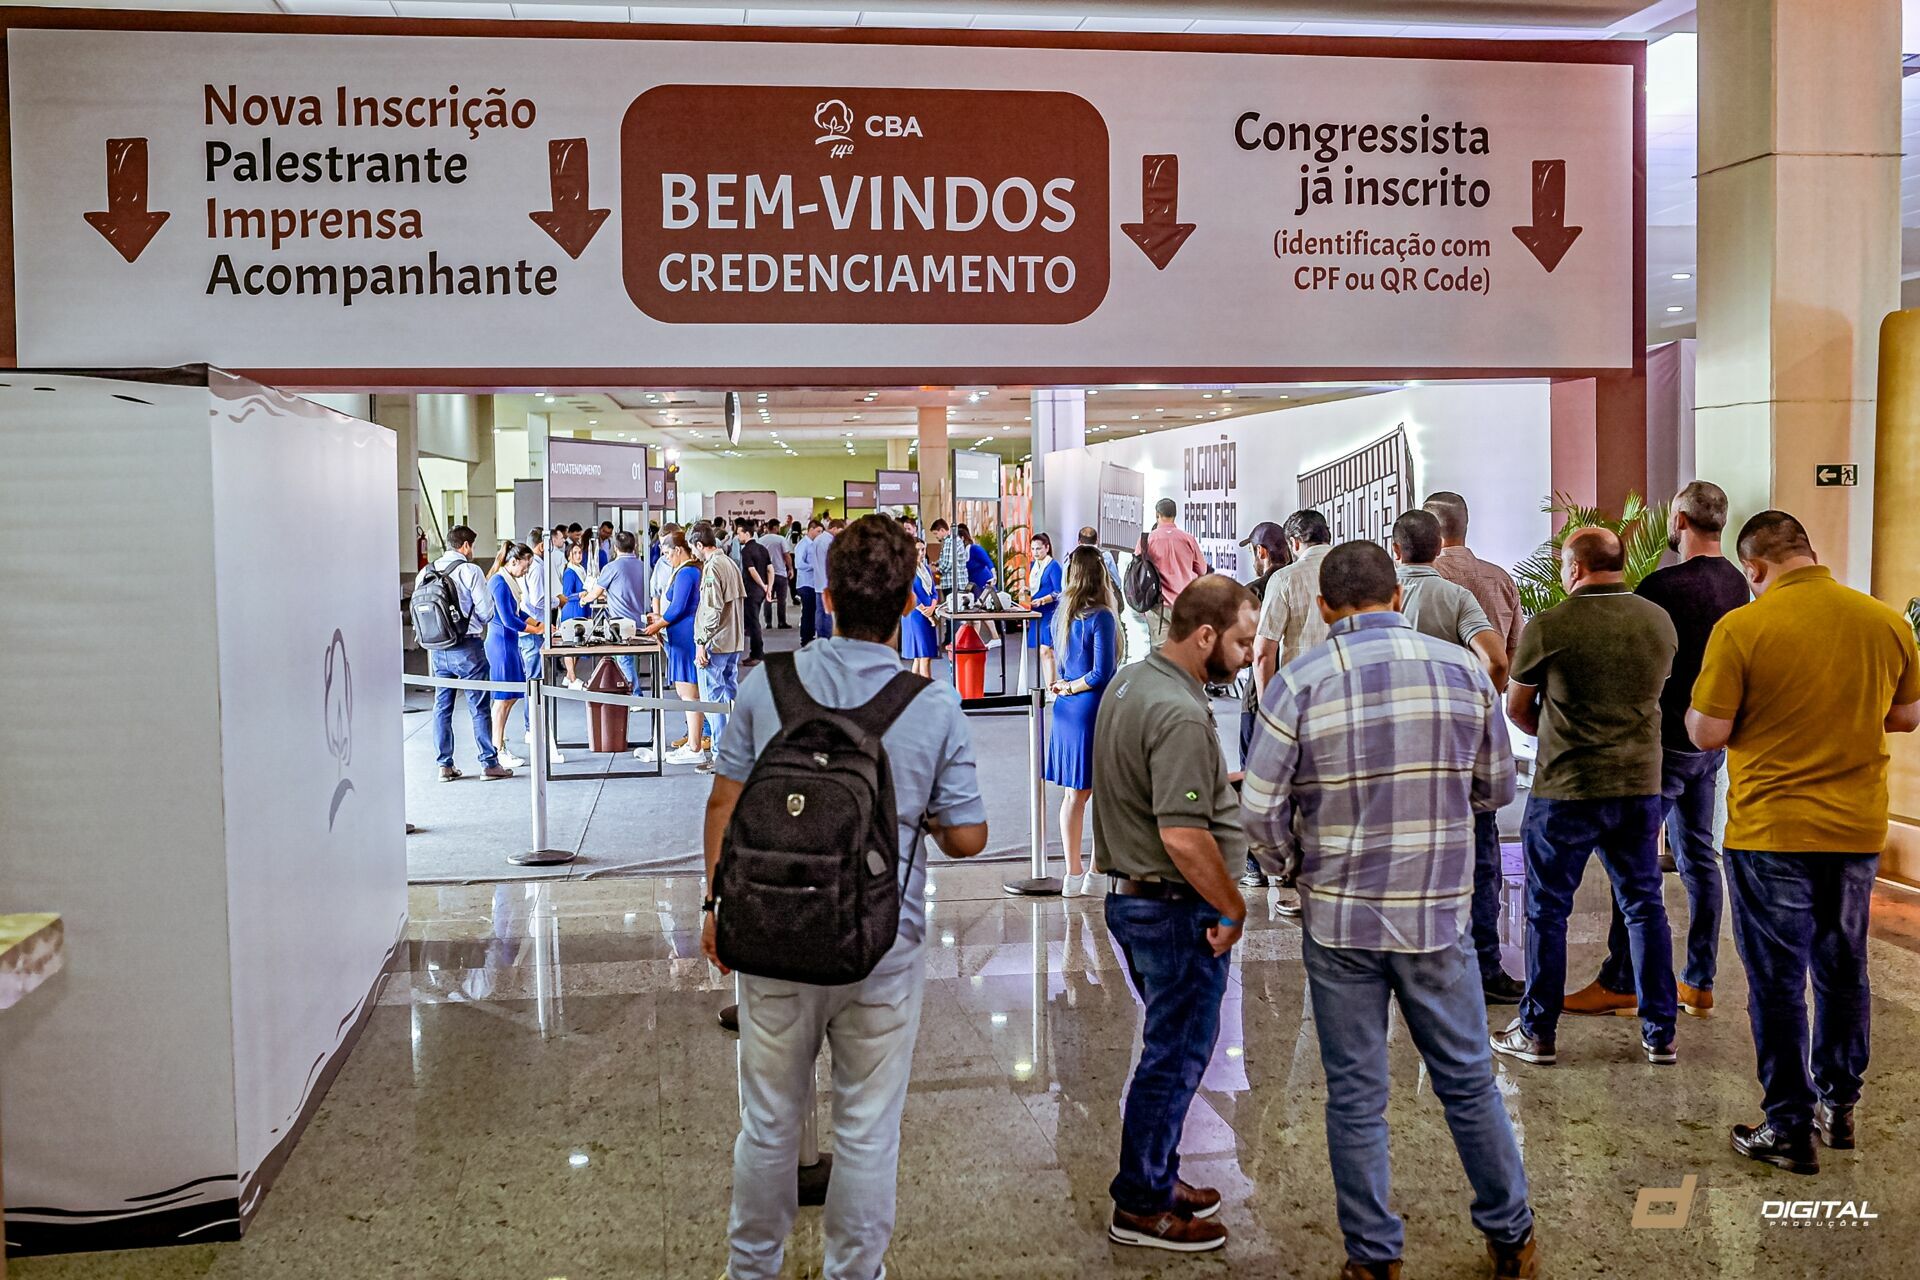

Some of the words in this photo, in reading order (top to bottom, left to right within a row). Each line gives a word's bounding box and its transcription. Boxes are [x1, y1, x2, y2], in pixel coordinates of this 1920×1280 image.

[204, 83, 323, 126] Nova
[336, 84, 537, 140] Inscrição
[864, 115, 924, 138] CBA
[205, 137, 468, 184] Palestrante
[1234, 112, 1490, 163] Congressista
[661, 172, 1076, 233] BEM-VINDOS
[1294, 164, 1333, 216] já
[1344, 165, 1491, 208] inscrito
[206, 197, 424, 251] Imprensa
[1273, 229, 1436, 263] (identificação
[1441, 238, 1491, 257] com
[205, 250, 558, 307] Acompanhante
[658, 252, 1076, 294] CREDENCIAMENTO
[1294, 267, 1340, 291] CPF
[1345, 272, 1375, 291] ou
[1380, 268, 1418, 295] QR
[1423, 266, 1490, 296] Code)
[551, 462, 602, 476] AUTOATENDIMENTO
[631, 462, 642, 481] 01
[654, 480, 663, 493] 03
[1184, 434, 1237, 497] ALGODÃO
[1184, 501, 1237, 543] BRASILEIRO
